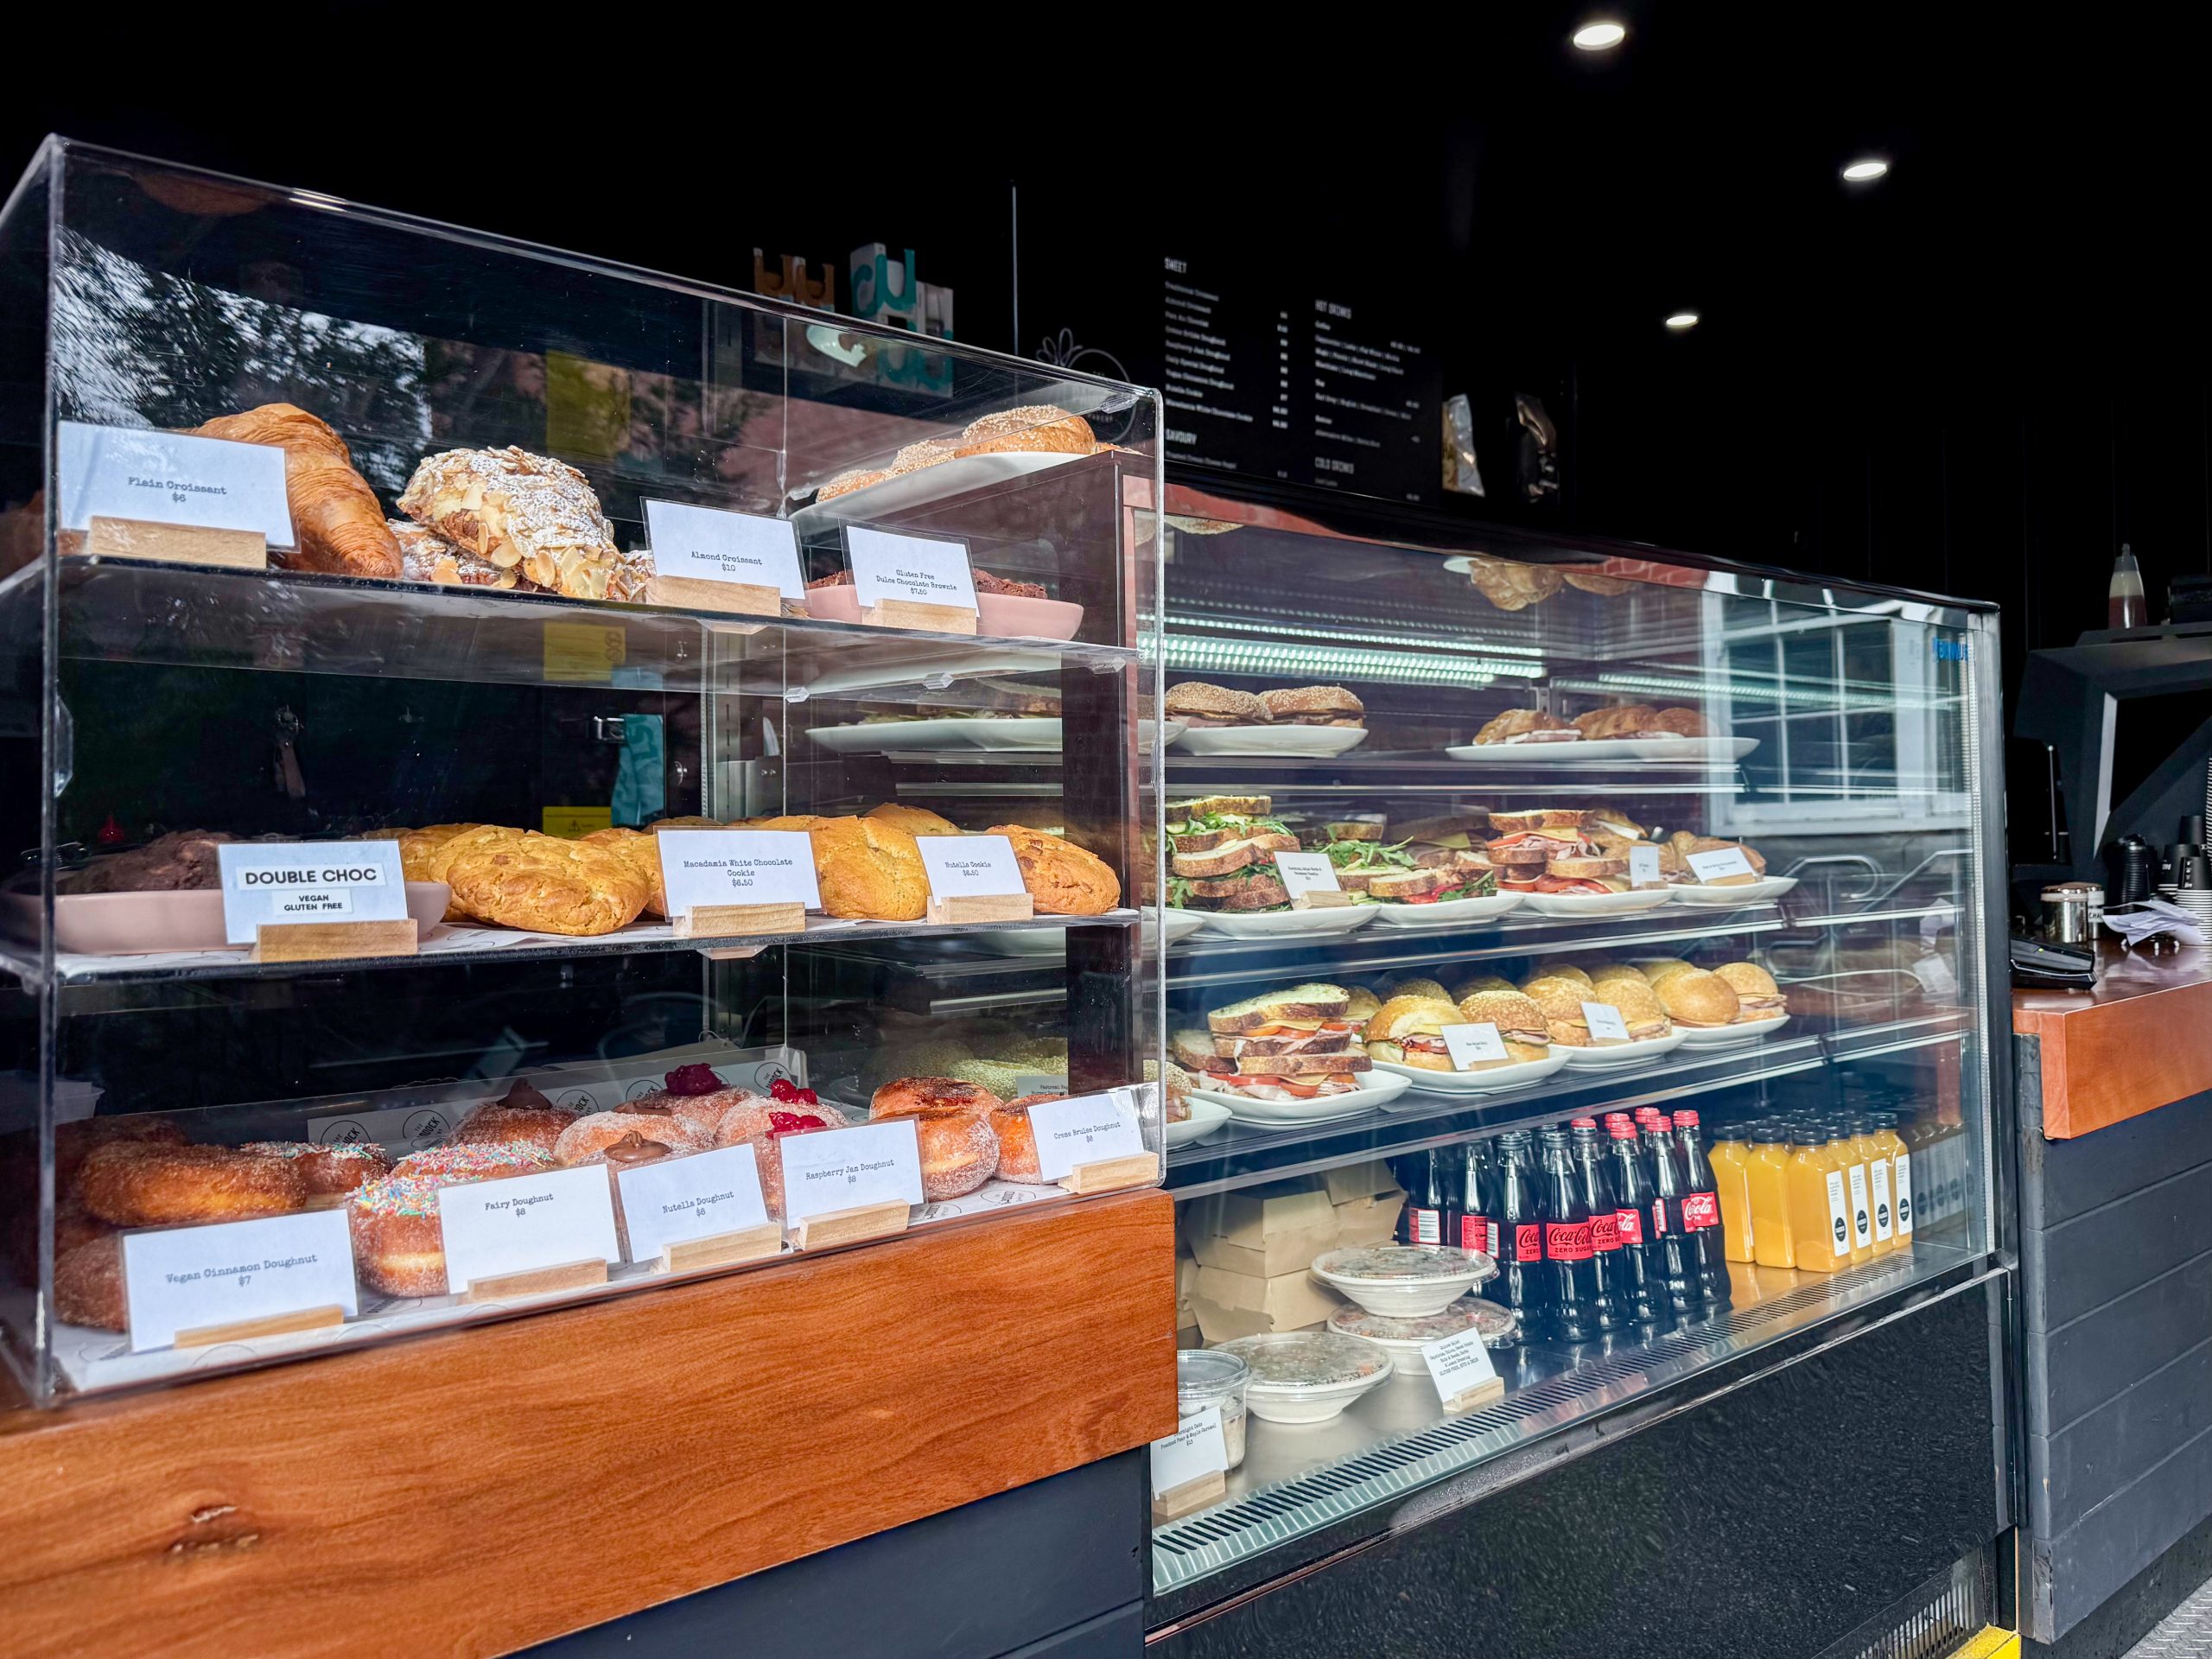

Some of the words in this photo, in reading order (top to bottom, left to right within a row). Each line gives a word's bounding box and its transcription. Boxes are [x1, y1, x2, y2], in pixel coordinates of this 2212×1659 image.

[128, 477, 163, 488] Plain
[166, 480, 227, 495] Croissant
[173, 492, 186, 503] $6
[691, 551, 721, 561] Almond
[721, 554, 762, 565] Croissant
[721, 563, 735, 572] $10
[896, 569, 918, 578] Gluten
[897, 578, 930, 588] Chocolate
[931, 582, 957, 590] Brownie
[245, 870, 317, 885] DOUBLE
[322, 868, 377, 882] CHOC
[732, 878, 753, 887] $6.50
[1093, 1122, 1121, 1132] Doughnut
[806, 1168, 844, 1180] Raspberry
[861, 1159, 894, 1171] Doughnut
[848, 1175, 856, 1185] $8
[485, 1201, 510, 1211] Fairy
[512, 1192, 553, 1206] Doughnut
[662, 1200, 695, 1214] Nutella
[696, 1191, 734, 1205] Doughnut
[516, 1207, 526, 1218] $8
[696, 1207, 706, 1217] $8
[166, 1272, 200, 1284] Vegan
[204, 1262, 261, 1278] Cinnamon
[263, 1254, 318, 1269] Doughnut
[238, 1274, 251, 1287] $7
